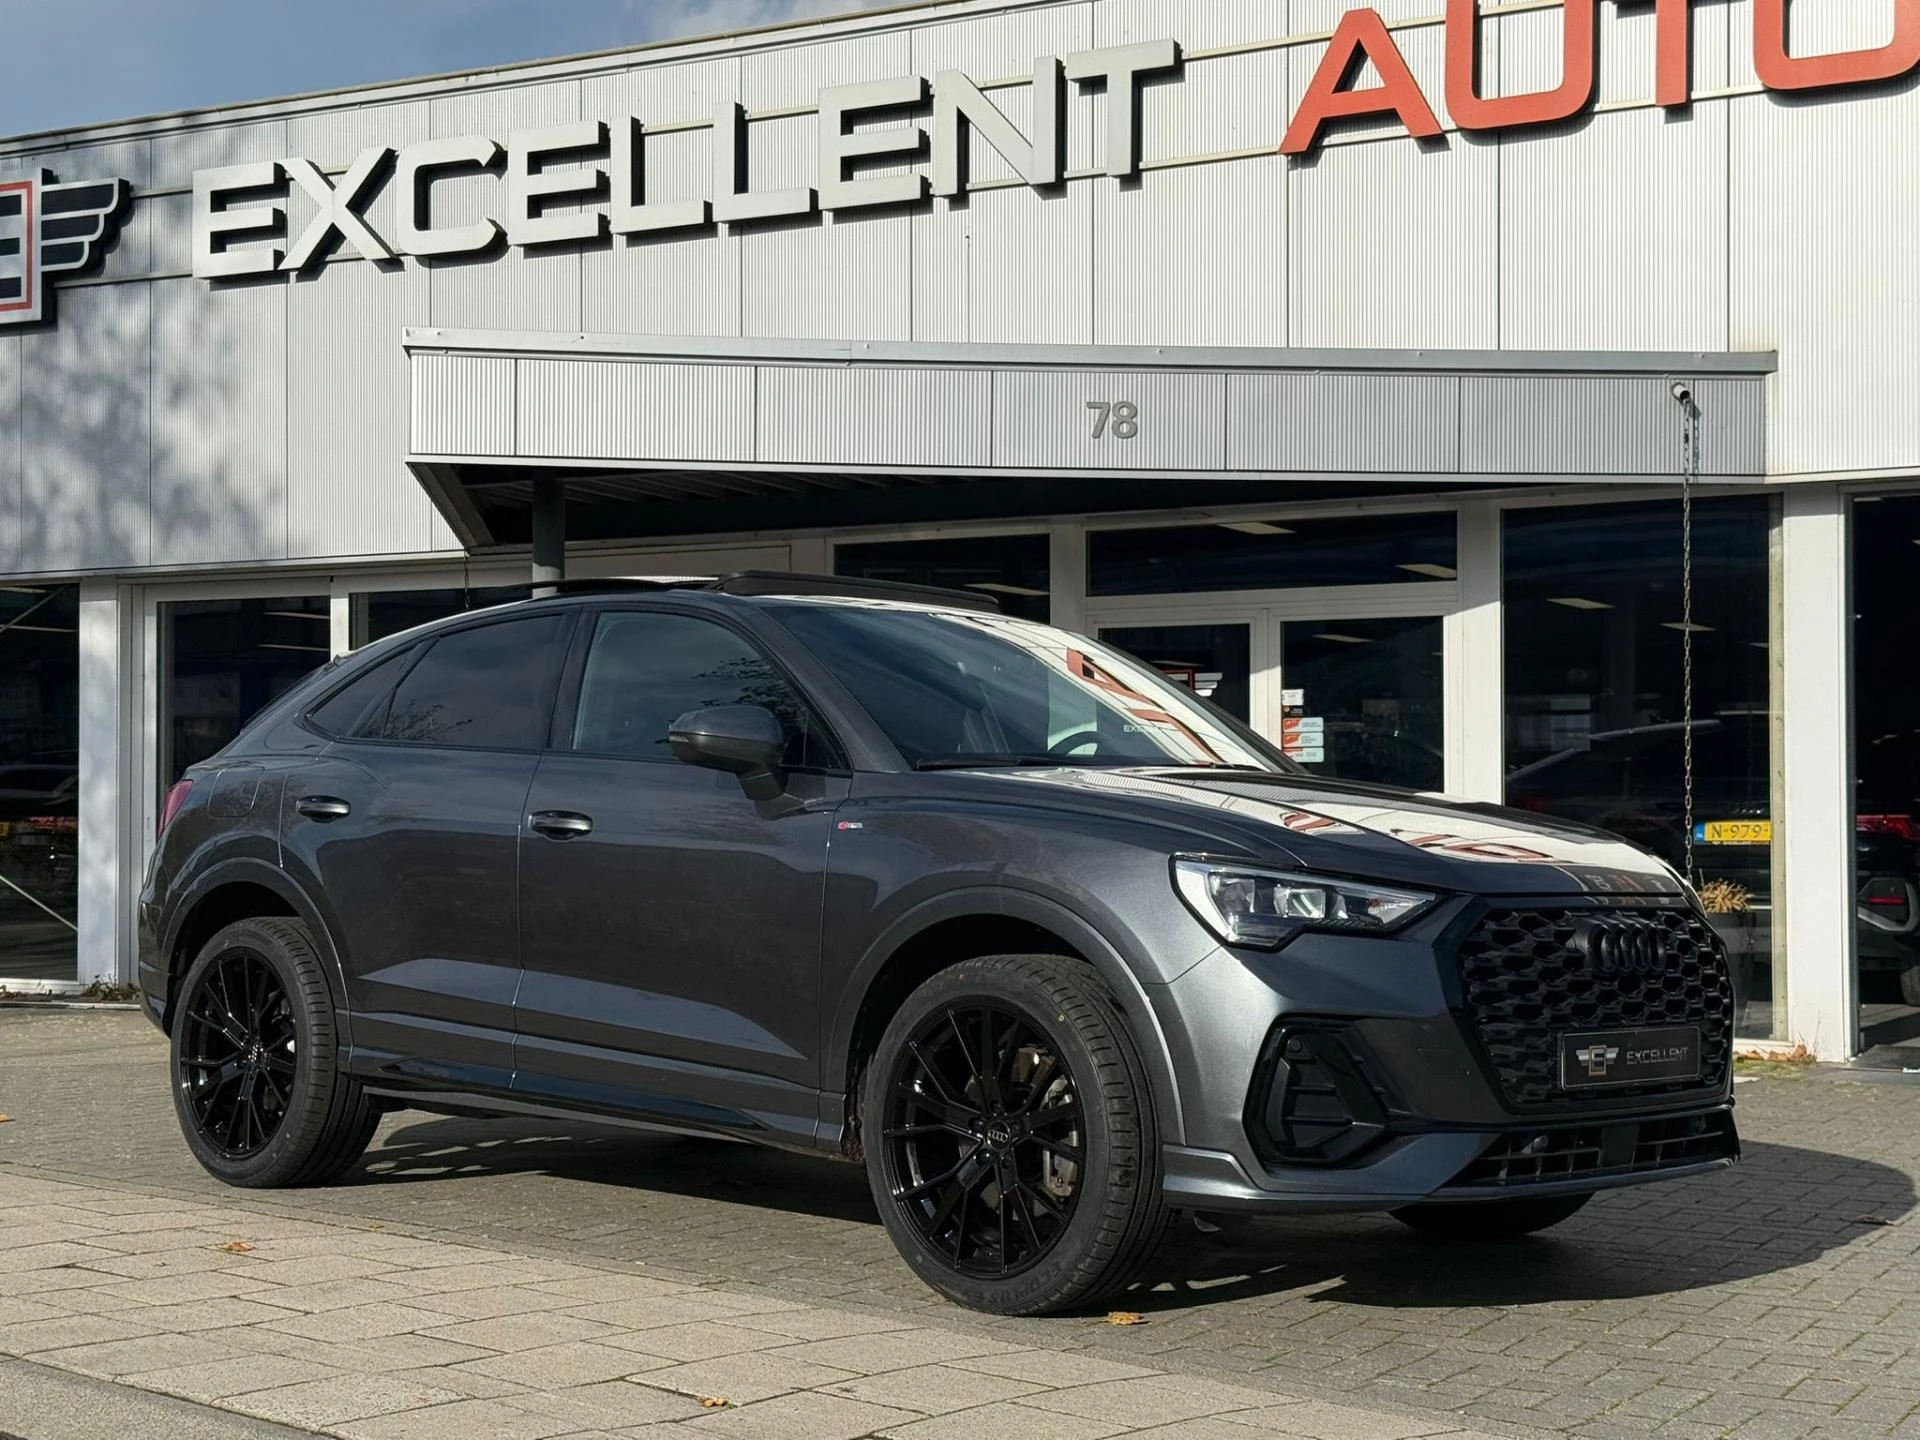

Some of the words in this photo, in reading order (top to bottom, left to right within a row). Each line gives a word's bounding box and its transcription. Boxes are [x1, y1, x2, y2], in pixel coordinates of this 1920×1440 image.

[192, 39, 1181, 280] EXCELLENT
[1086, 401, 1138, 439] 78
[1626, 1046, 1688, 1065] EXCELLENT
